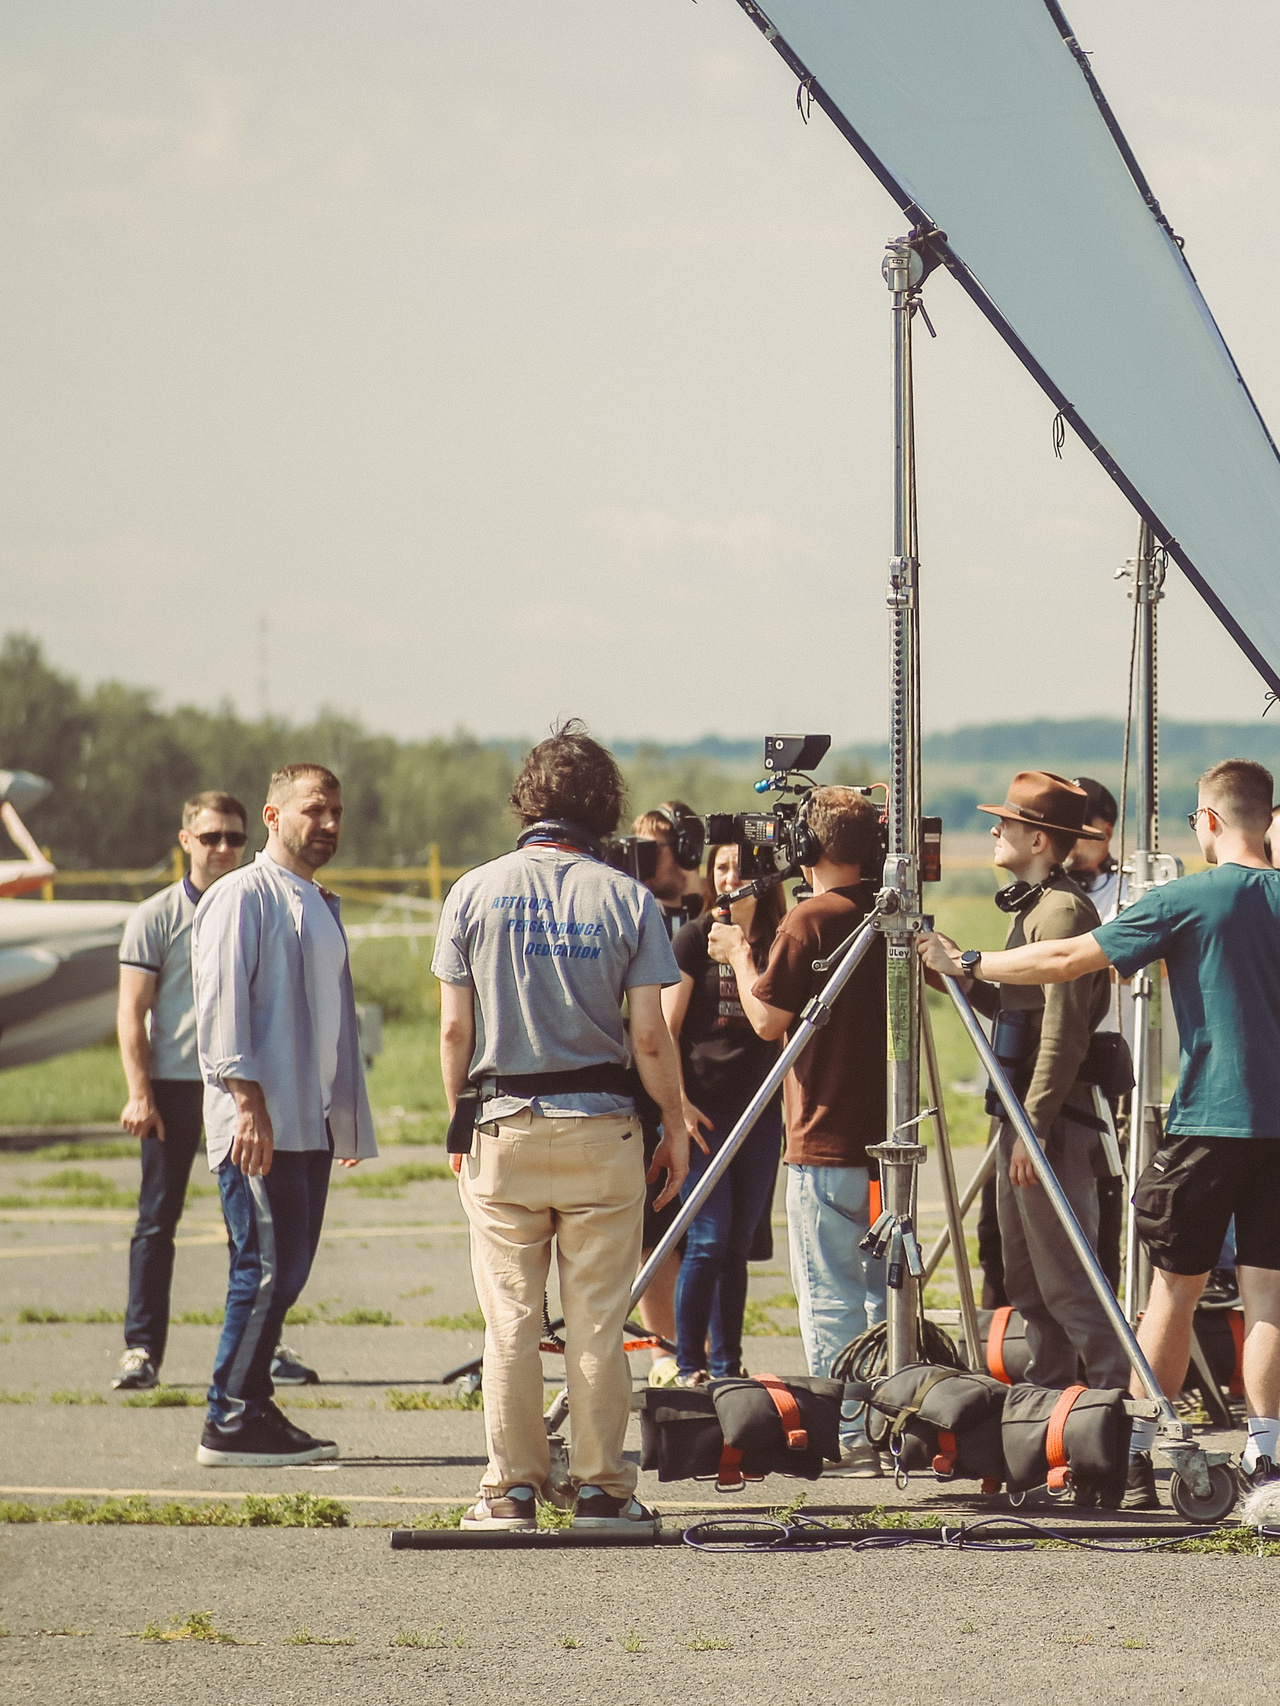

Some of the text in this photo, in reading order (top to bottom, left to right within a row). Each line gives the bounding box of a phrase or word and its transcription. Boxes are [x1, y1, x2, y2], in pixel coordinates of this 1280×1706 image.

[491, 896, 553, 910] ATTITUDE
[506, 919, 603, 937] PERSEVERANCE
[525, 942, 602, 959] DEDCATION
